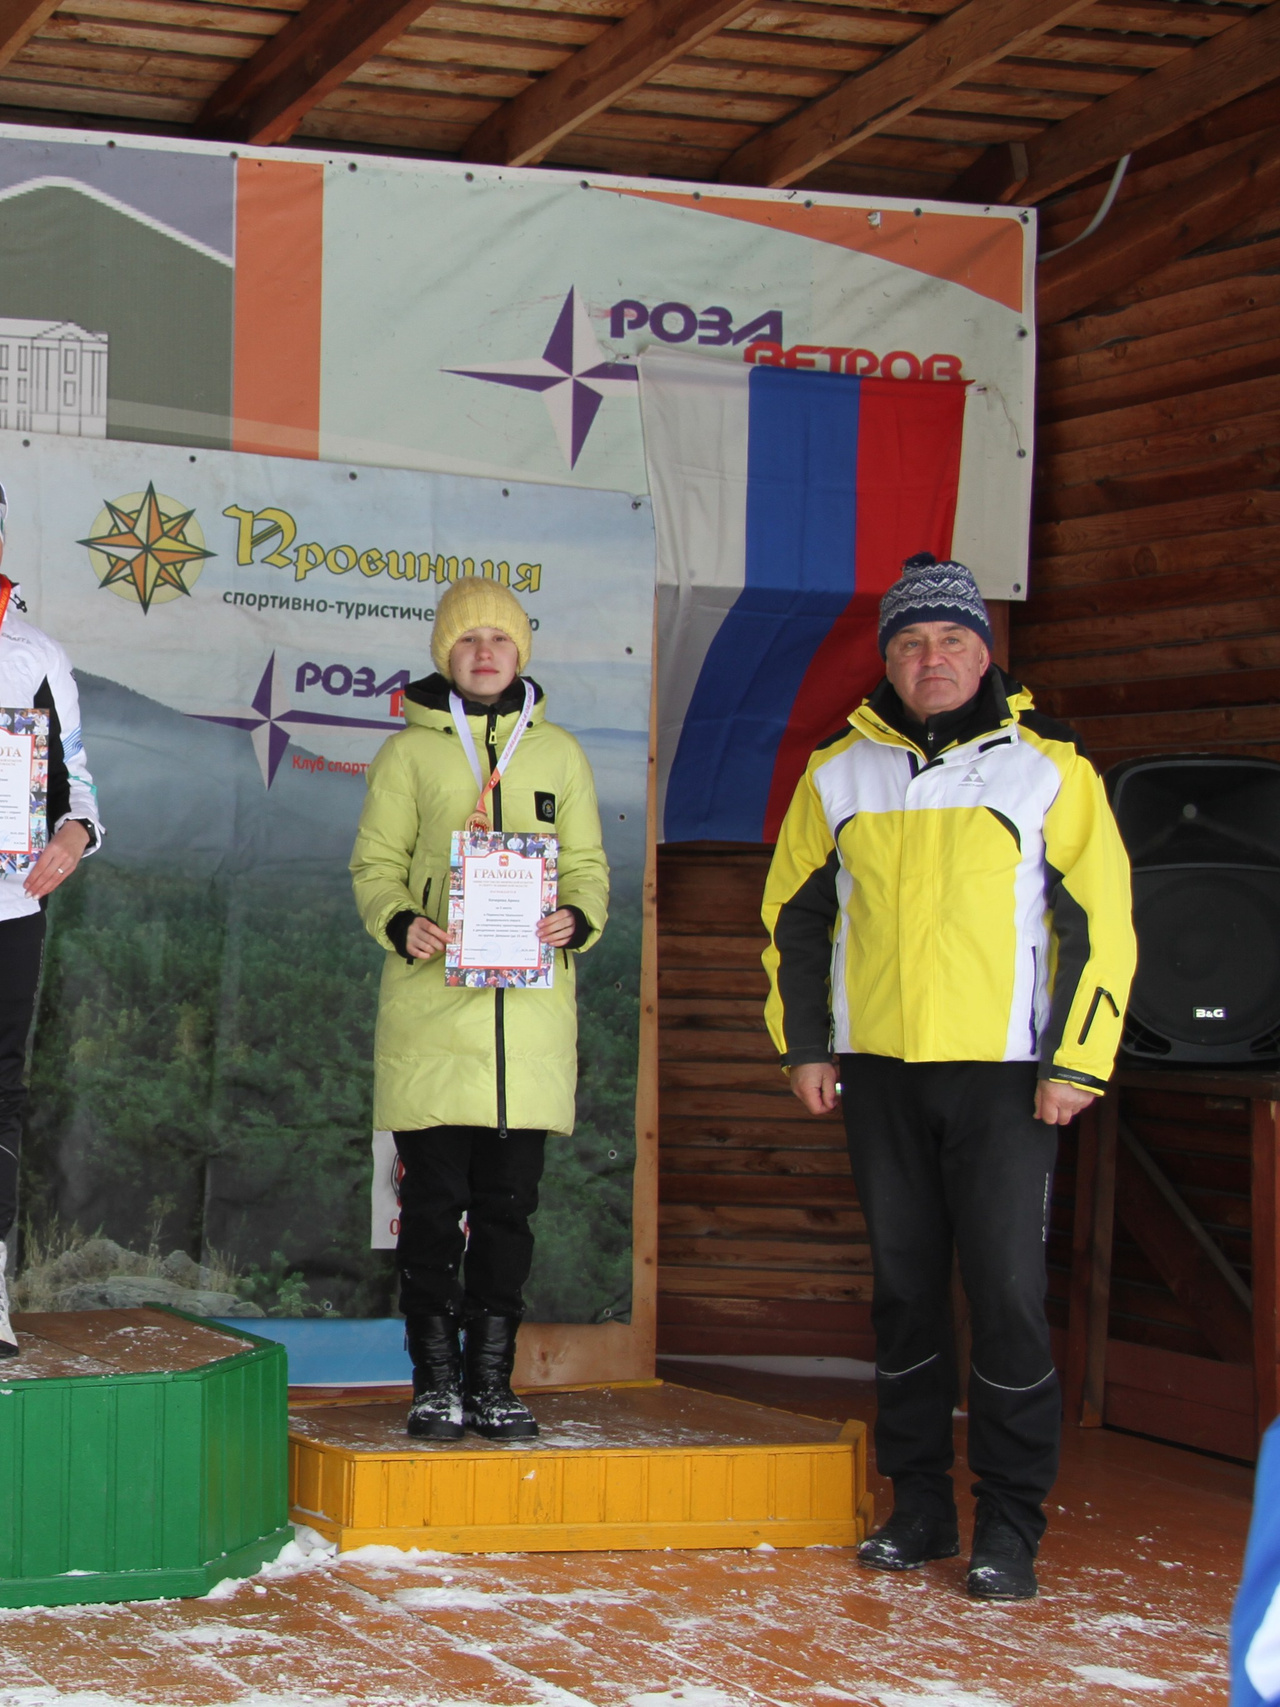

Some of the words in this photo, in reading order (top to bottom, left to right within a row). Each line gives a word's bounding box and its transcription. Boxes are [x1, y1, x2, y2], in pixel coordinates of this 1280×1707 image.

[610, 299, 783, 346] РОЗА
[222, 590, 435, 621] спортивно-туристиче
[295, 662, 410, 698] РОЗА
[292, 754, 325, 773] Клуб
[327, 759, 371, 777] спорт
[474, 869, 533, 879] ГРАМОТА
[1195, 1008, 1224, 1018] B&G
